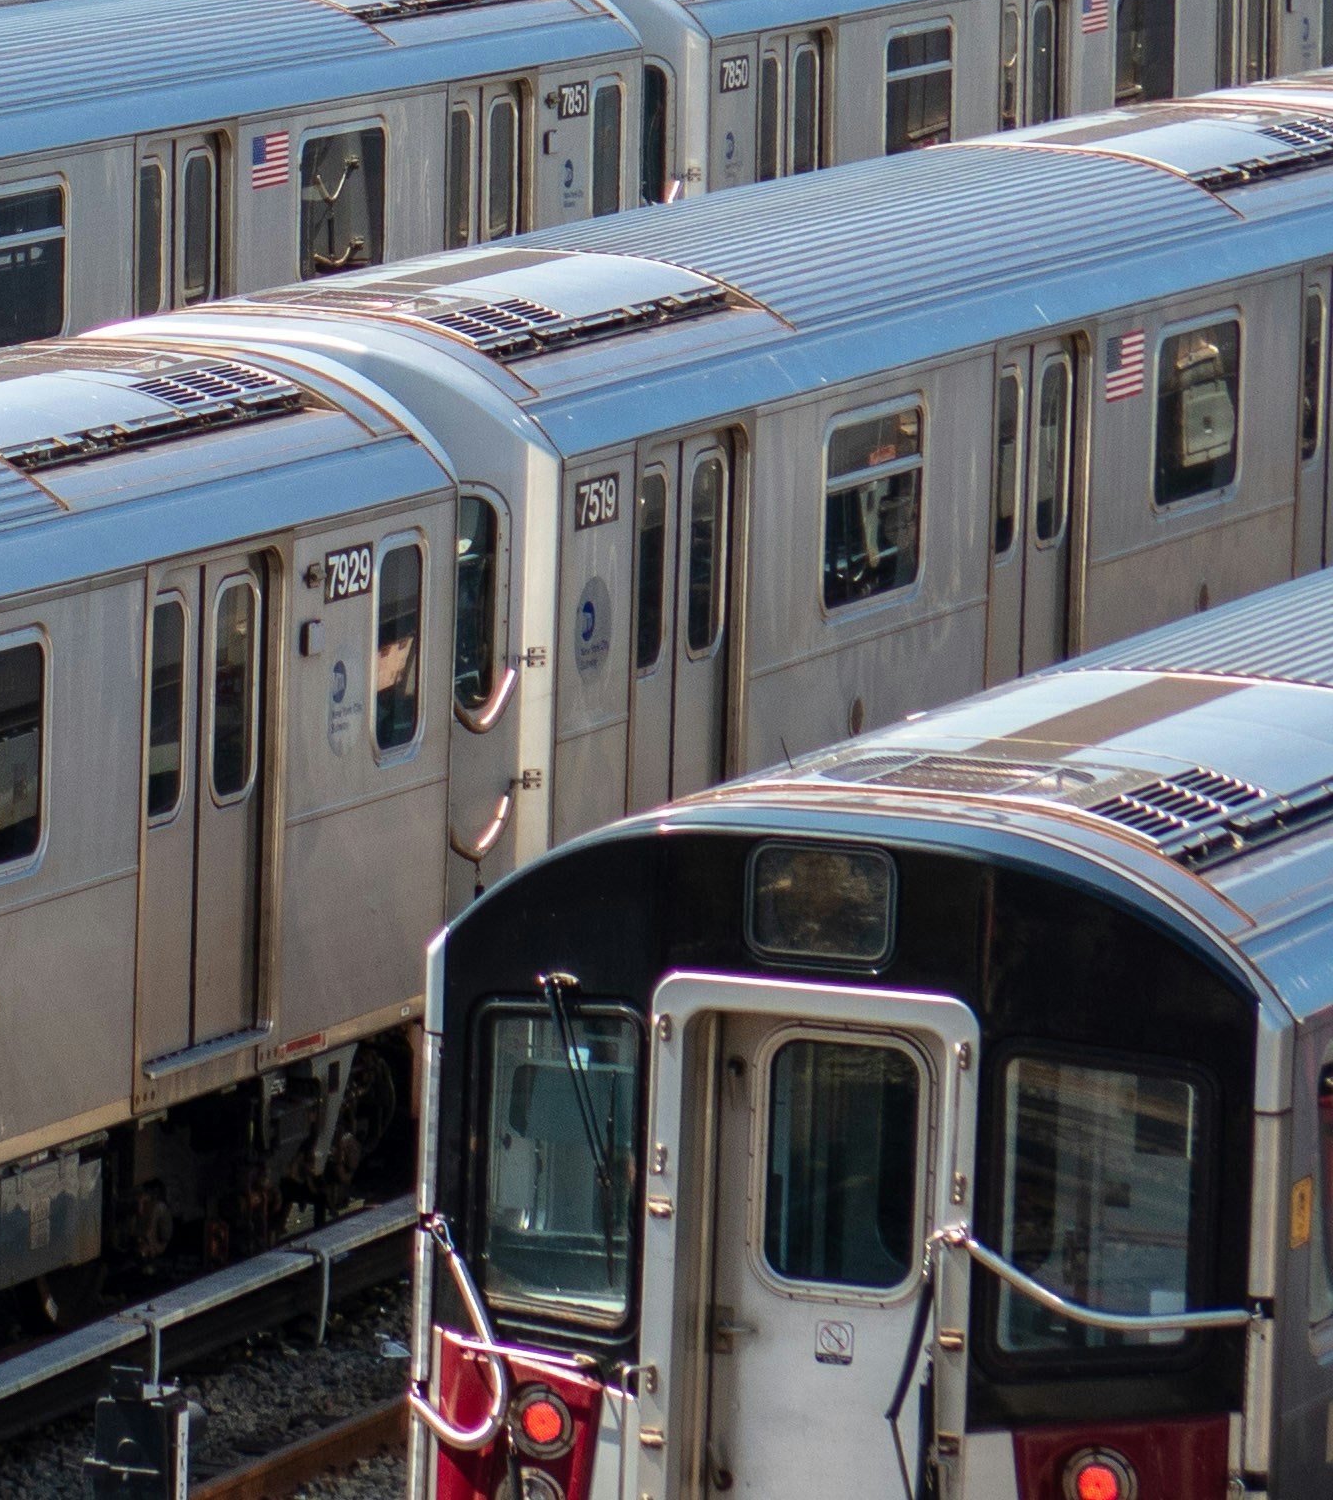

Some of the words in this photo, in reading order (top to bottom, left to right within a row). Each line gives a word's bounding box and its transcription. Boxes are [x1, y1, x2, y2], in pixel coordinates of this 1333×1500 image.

[723, 58, 749, 91] 7850
[561, 84, 587, 116] 7851
[580, 478, 616, 525] 7519
[328, 549, 371, 598] 7929
